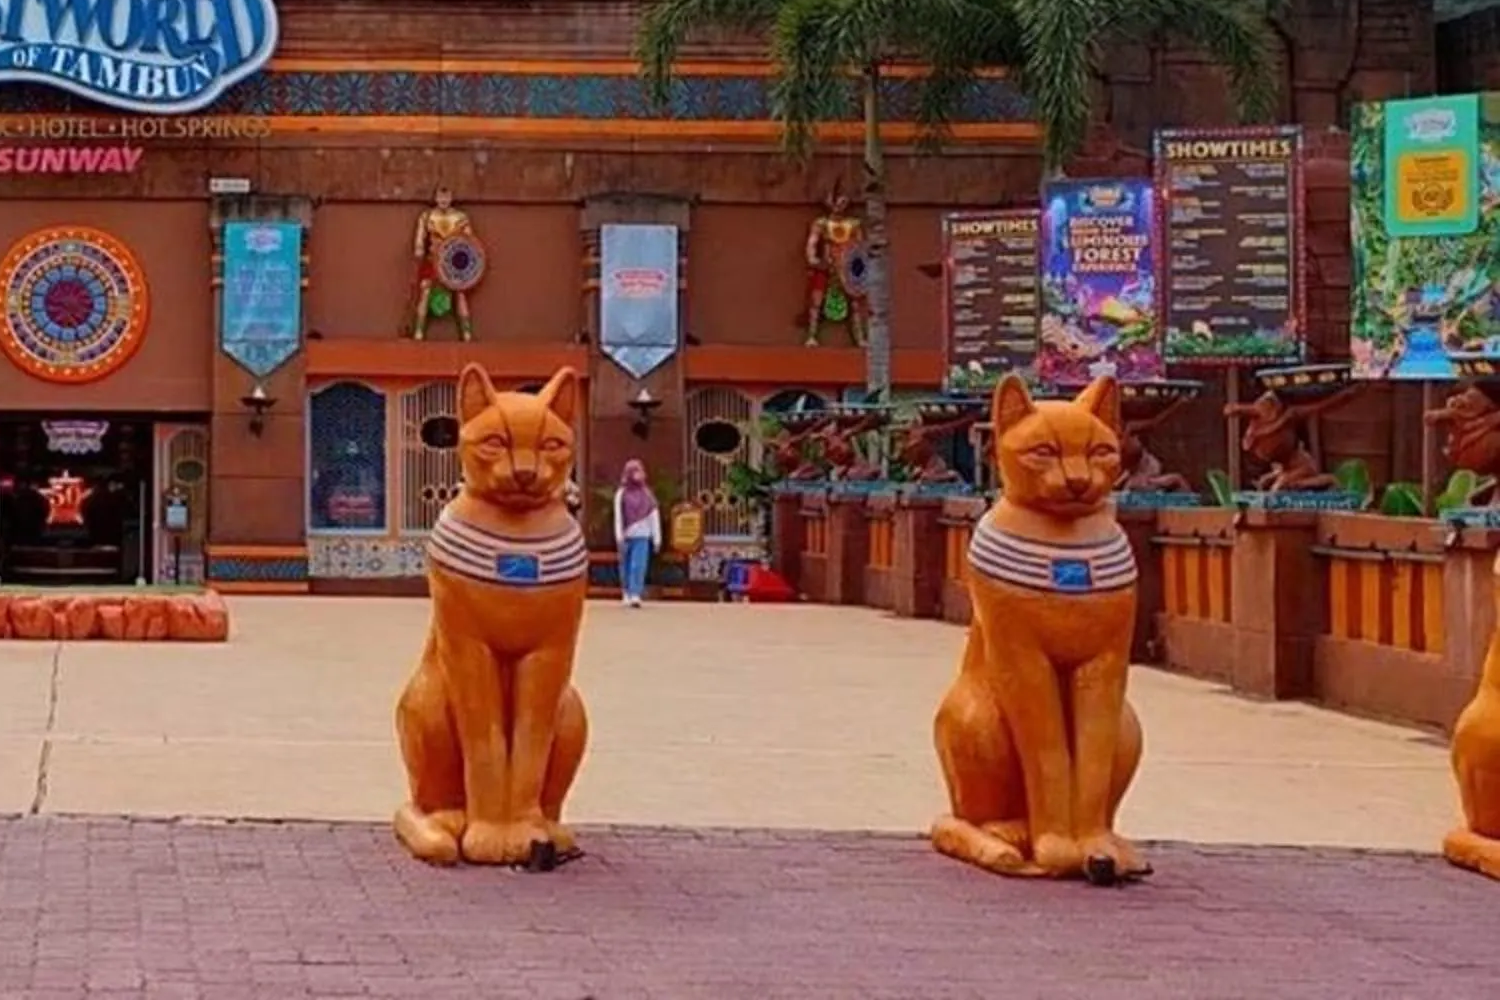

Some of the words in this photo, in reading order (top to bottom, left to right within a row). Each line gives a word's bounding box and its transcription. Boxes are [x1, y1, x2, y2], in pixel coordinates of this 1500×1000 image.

[12, 46, 41, 68] OF
[51, 47, 213, 98] TAMBUN
[30, 116, 103, 138] HOTEL
[121, 116, 171, 138] HOT
[174, 116, 271, 138] SPRINGS
[1166, 140, 1291, 158] SHOWTIMES
[1074, 247, 1141, 262] FOREST
